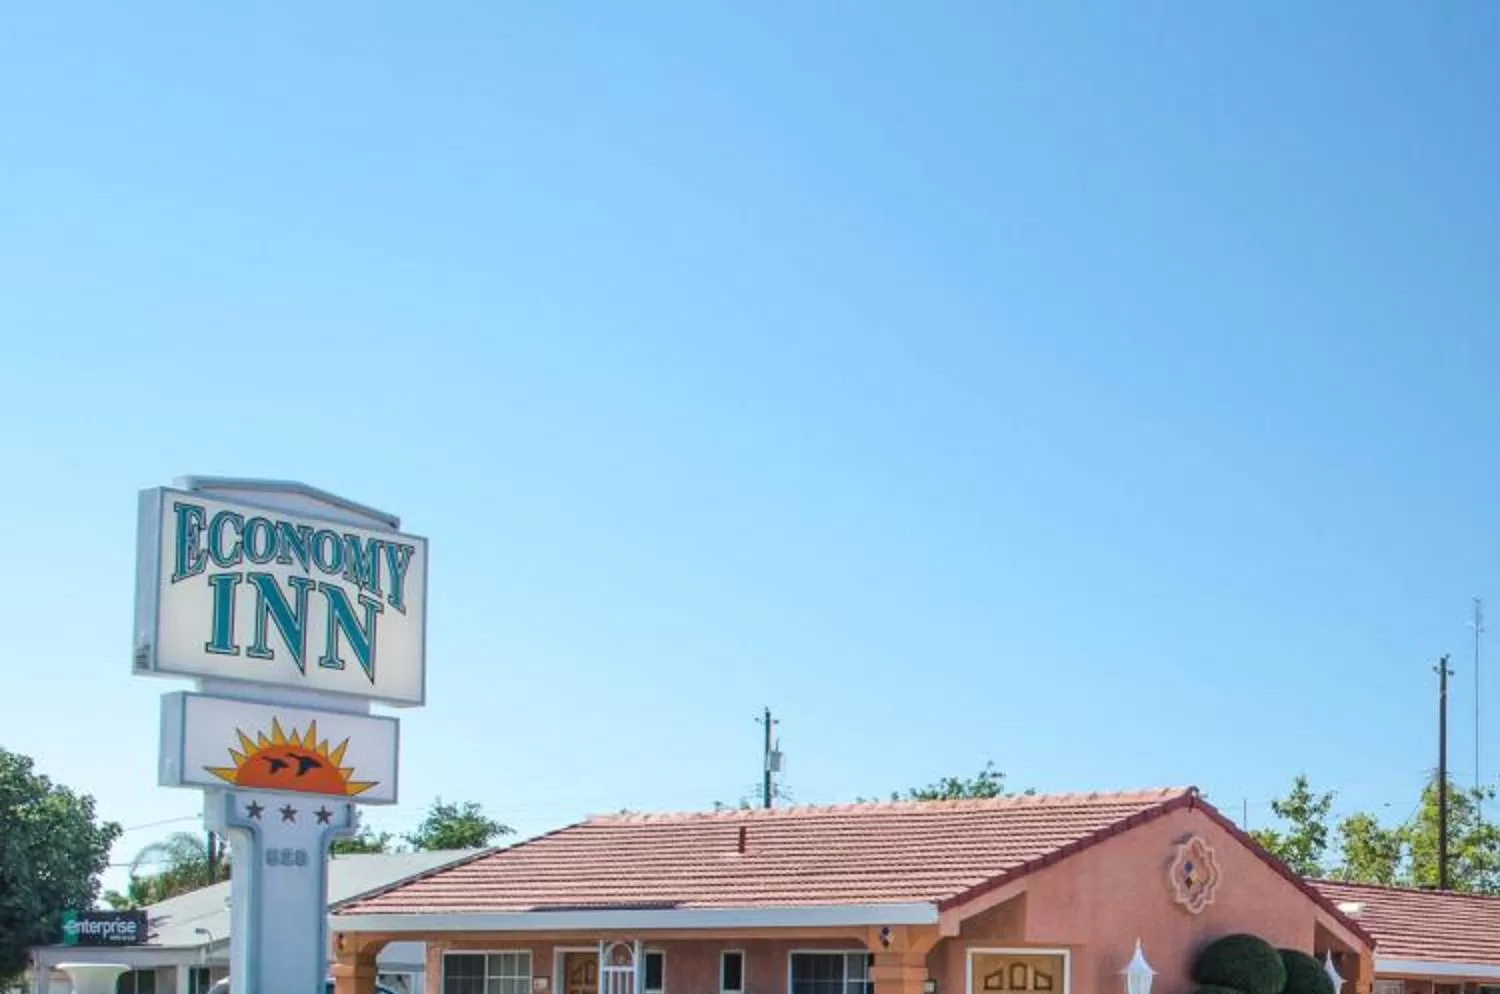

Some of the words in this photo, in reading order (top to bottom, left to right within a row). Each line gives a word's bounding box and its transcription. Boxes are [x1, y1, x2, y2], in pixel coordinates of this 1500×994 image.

[171, 501, 415, 616] ECONOMY
[204, 571, 384, 685] INN
[63, 917, 137, 938] enterprise
